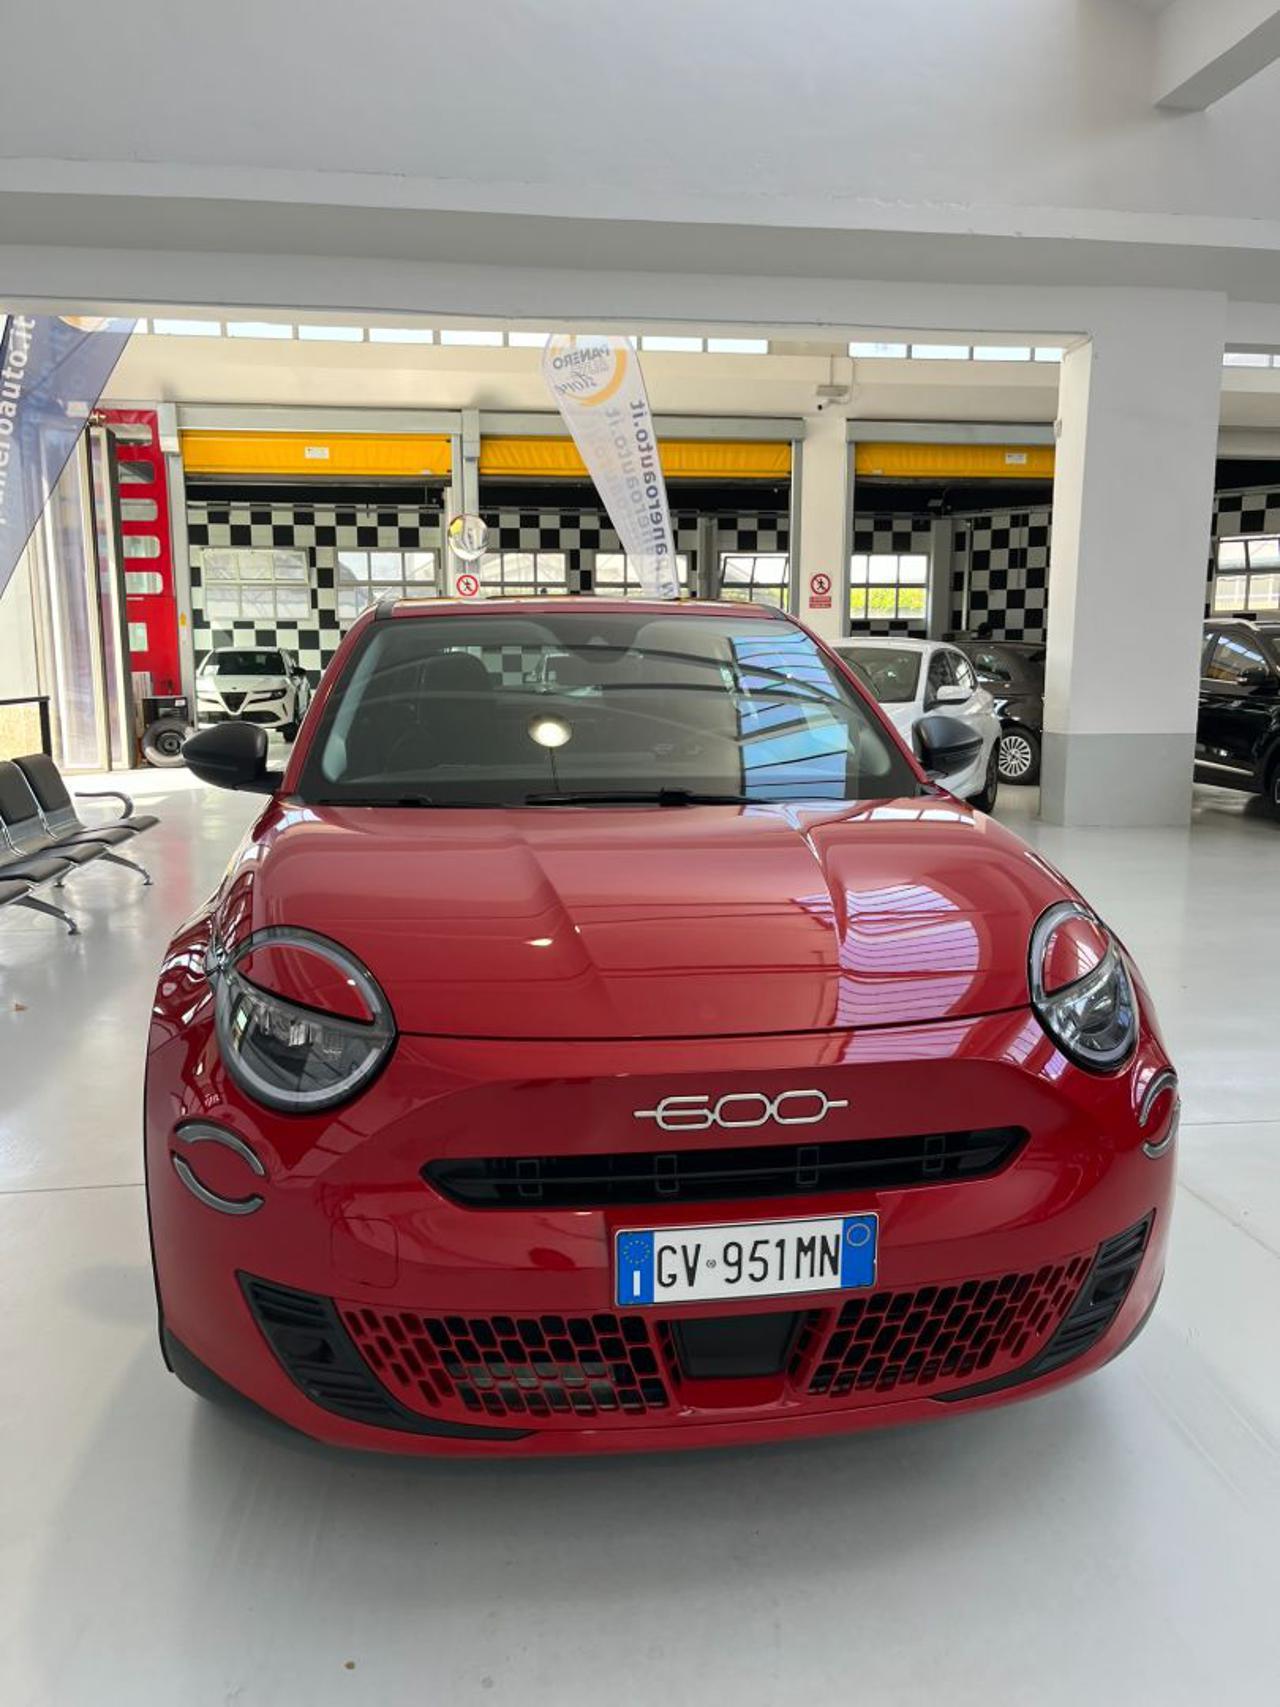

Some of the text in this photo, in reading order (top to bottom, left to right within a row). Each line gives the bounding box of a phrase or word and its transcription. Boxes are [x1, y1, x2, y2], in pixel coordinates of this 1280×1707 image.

[655, 1089, 829, 1131] 600
[656, 1233, 841, 1289] GV 951MN
